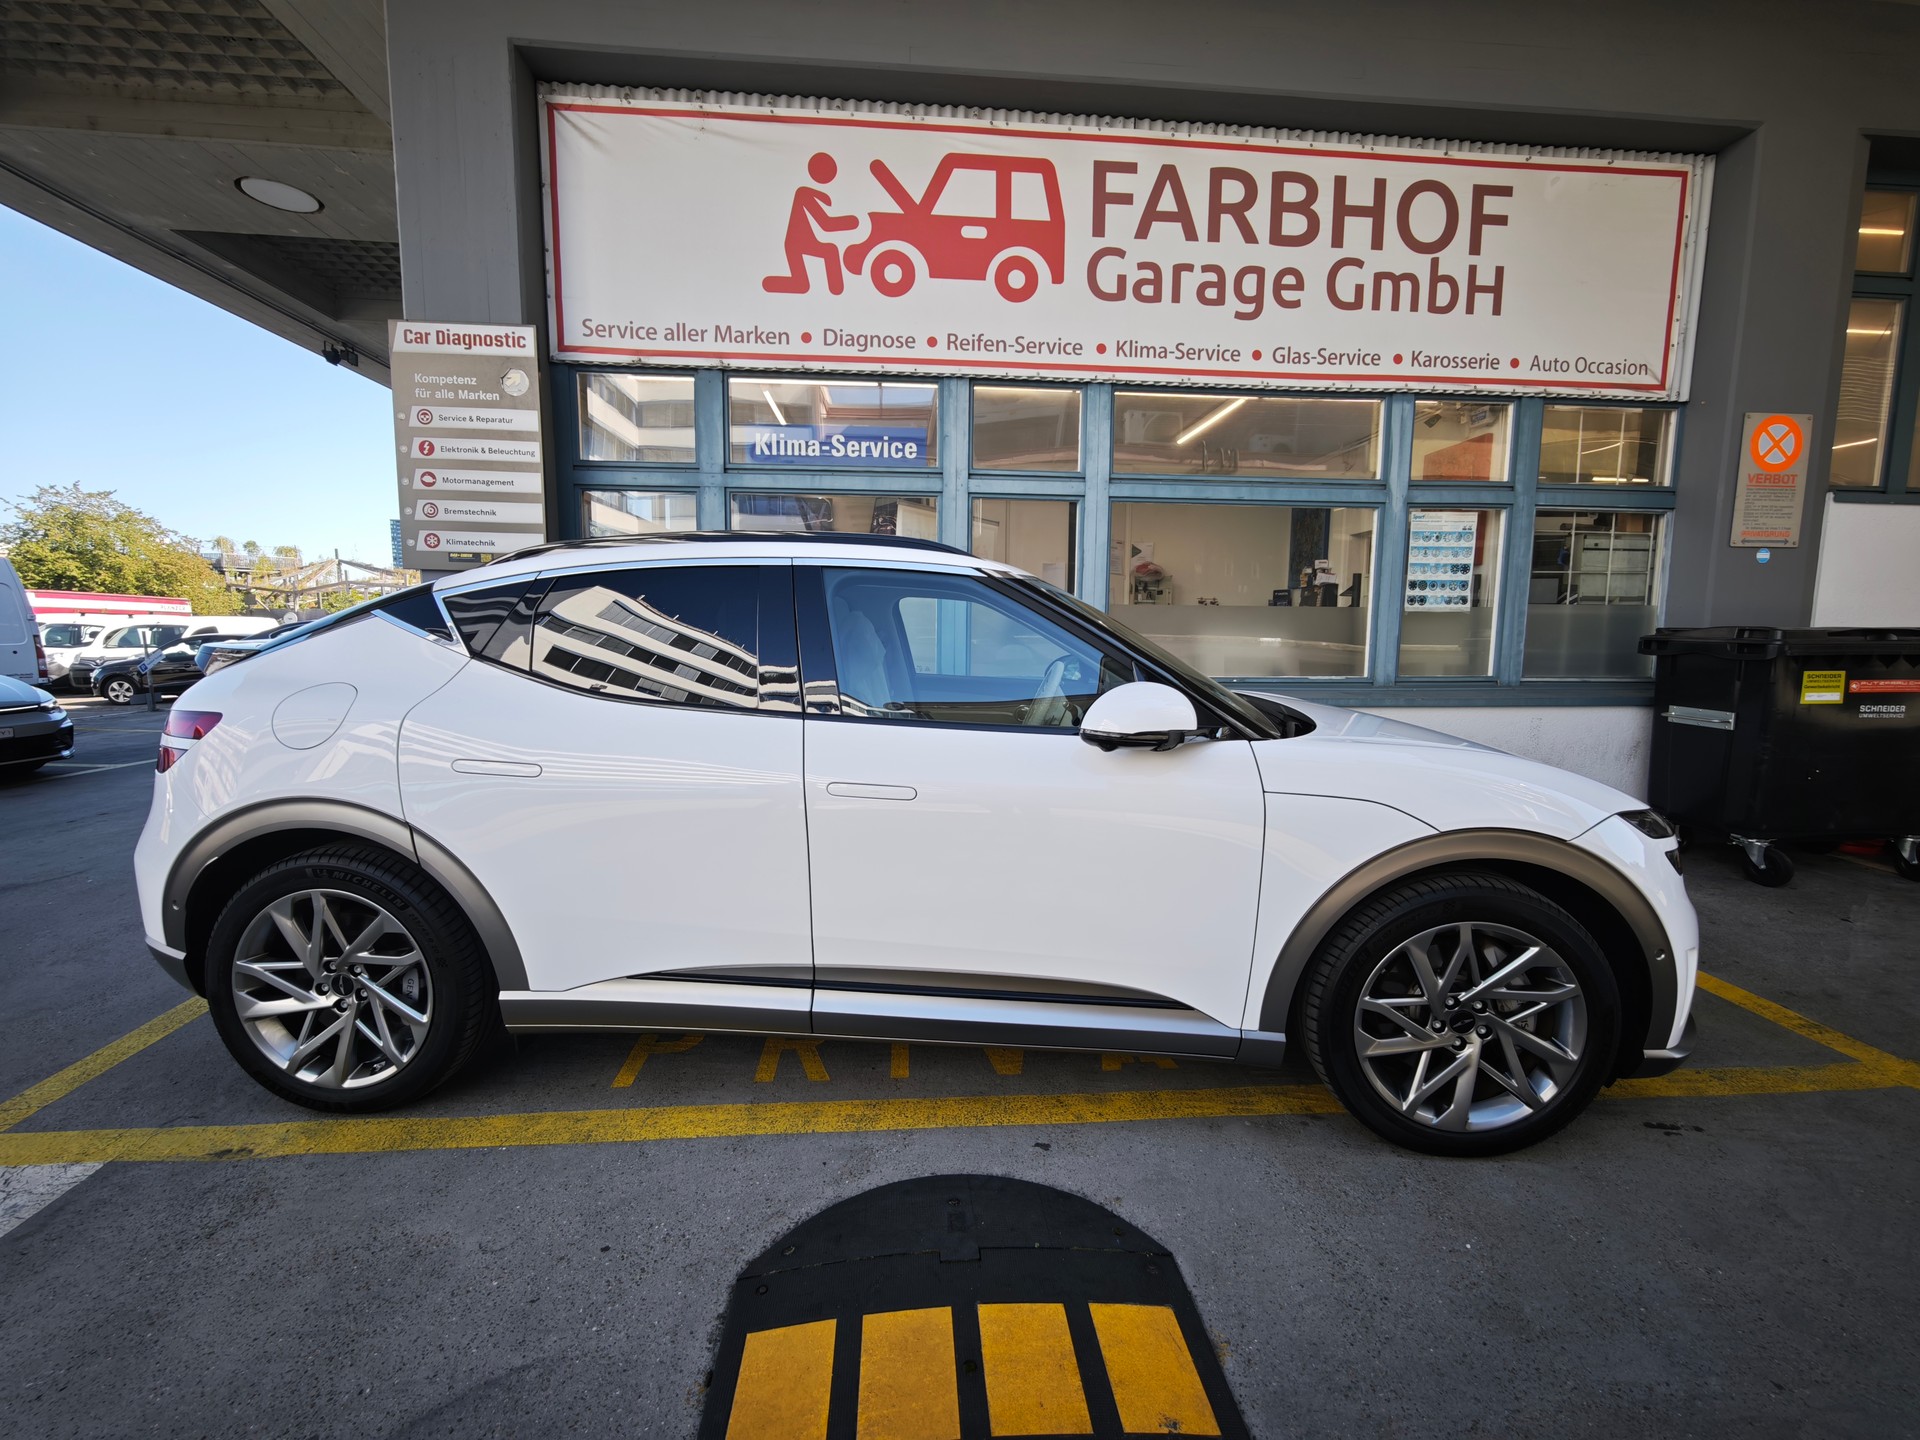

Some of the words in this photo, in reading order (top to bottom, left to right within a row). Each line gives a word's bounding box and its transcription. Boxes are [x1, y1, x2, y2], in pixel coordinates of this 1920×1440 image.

[1091, 158, 1514, 257] FARBHOF
[1086, 246, 1305, 322] Garage
[1326, 255, 1505, 316] GmbH
[403, 328, 431, 345] Car
[435, 328, 527, 350] Diagnostic
[582, 318, 657, 341] Service
[664, 322, 708, 343] aller
[714, 324, 790, 345] Marken
[823, 328, 916, 352] Diagnose
[946, 332, 1083, 356] Reifen-Service
[1116, 340, 1241, 362] Klima-Service
[1272, 346, 1381, 366] Glas-Service
[1411, 351, 1500, 370] Karosserie
[1530, 355, 1570, 373] Auto
[1575, 356, 1648, 376] Occasion
[414, 372, 477, 386] Kompetenz
[415, 388, 431, 399] für
[435, 389, 455, 399] alle
[458, 390, 500, 401] Marken
[438, 414, 467, 423] Service
[475, 415, 513, 425] Reparatur
[440, 446, 479, 454] Elektronik
[488, 448, 536, 458] Beleuchtung
[755, 433, 918, 459] Klima-Service
[442, 477, 515, 487] Motormanagement
[1748, 473, 1798, 485] VERBOT
[444, 508, 497, 516] Bremstechnik
[446, 539, 496, 547] Klimatechnik
[1860, 705, 1906, 713] SCHNEIDER
[332, 871, 405, 908] MICHELIN
